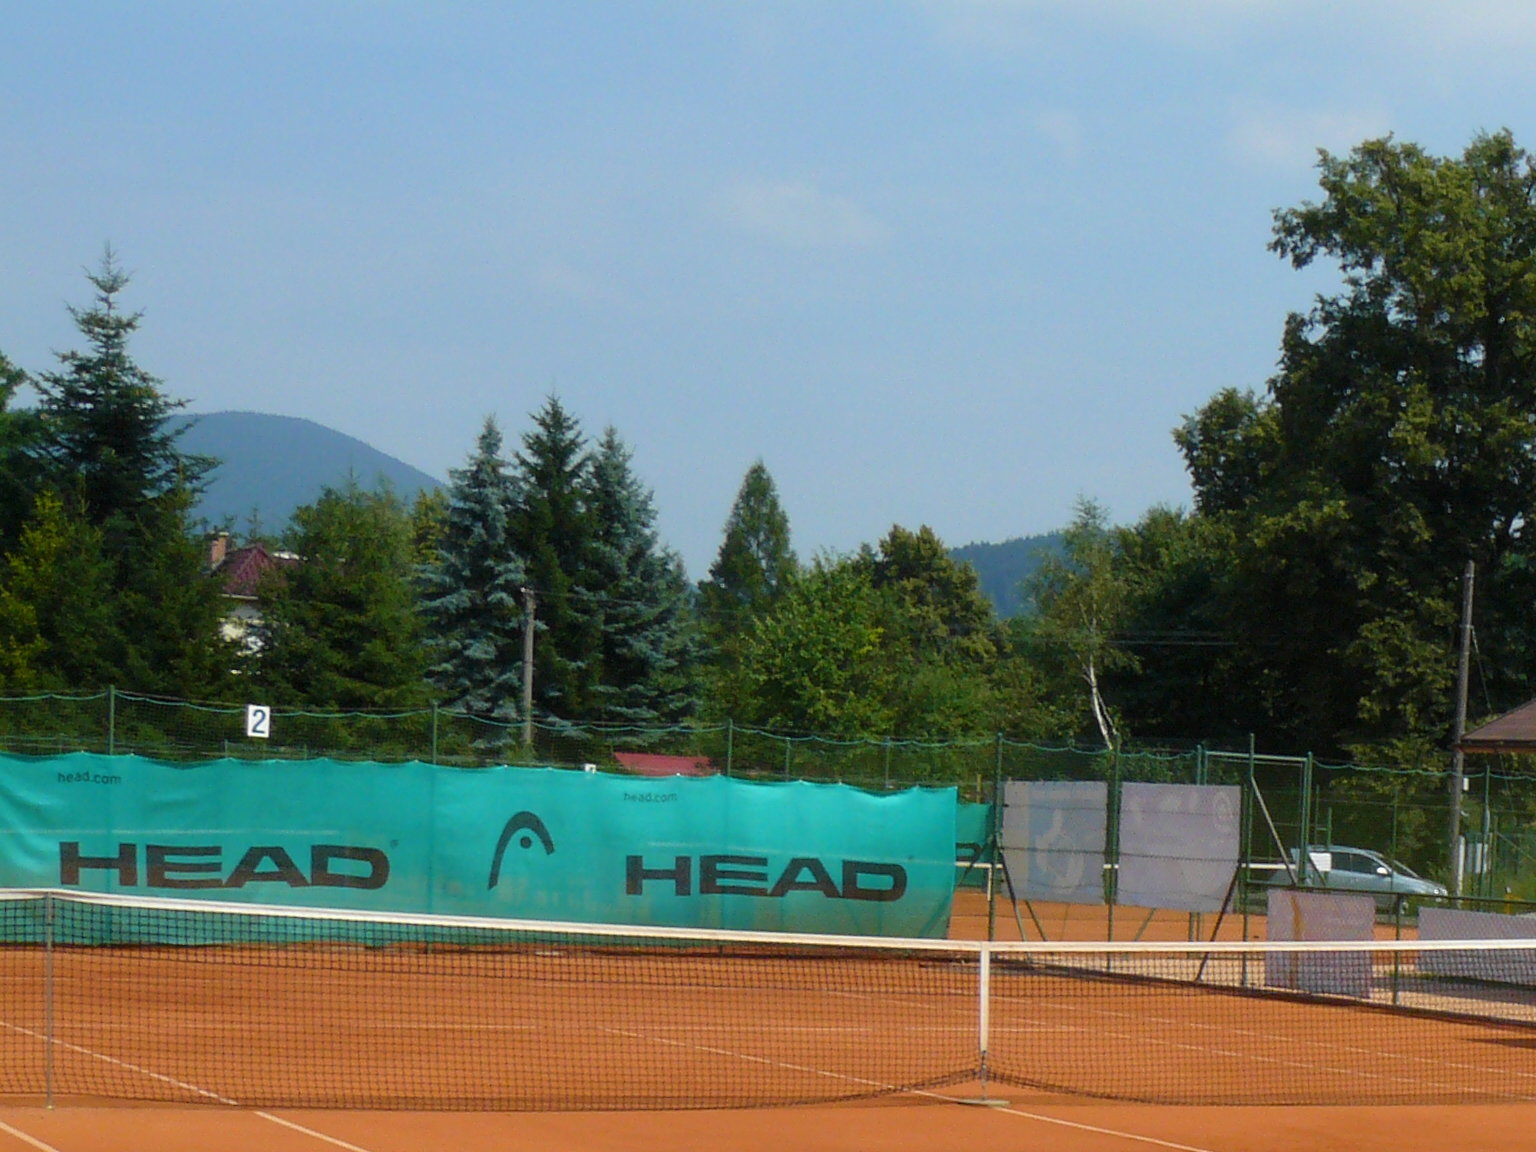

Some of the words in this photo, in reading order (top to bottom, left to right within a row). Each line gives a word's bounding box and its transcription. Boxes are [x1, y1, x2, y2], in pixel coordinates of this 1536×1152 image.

[252, 709, 266, 733] 2
[57, 771, 122, 784] head.com
[59, 841, 390, 890] HEAD
[625, 855, 908, 902] HEAD
